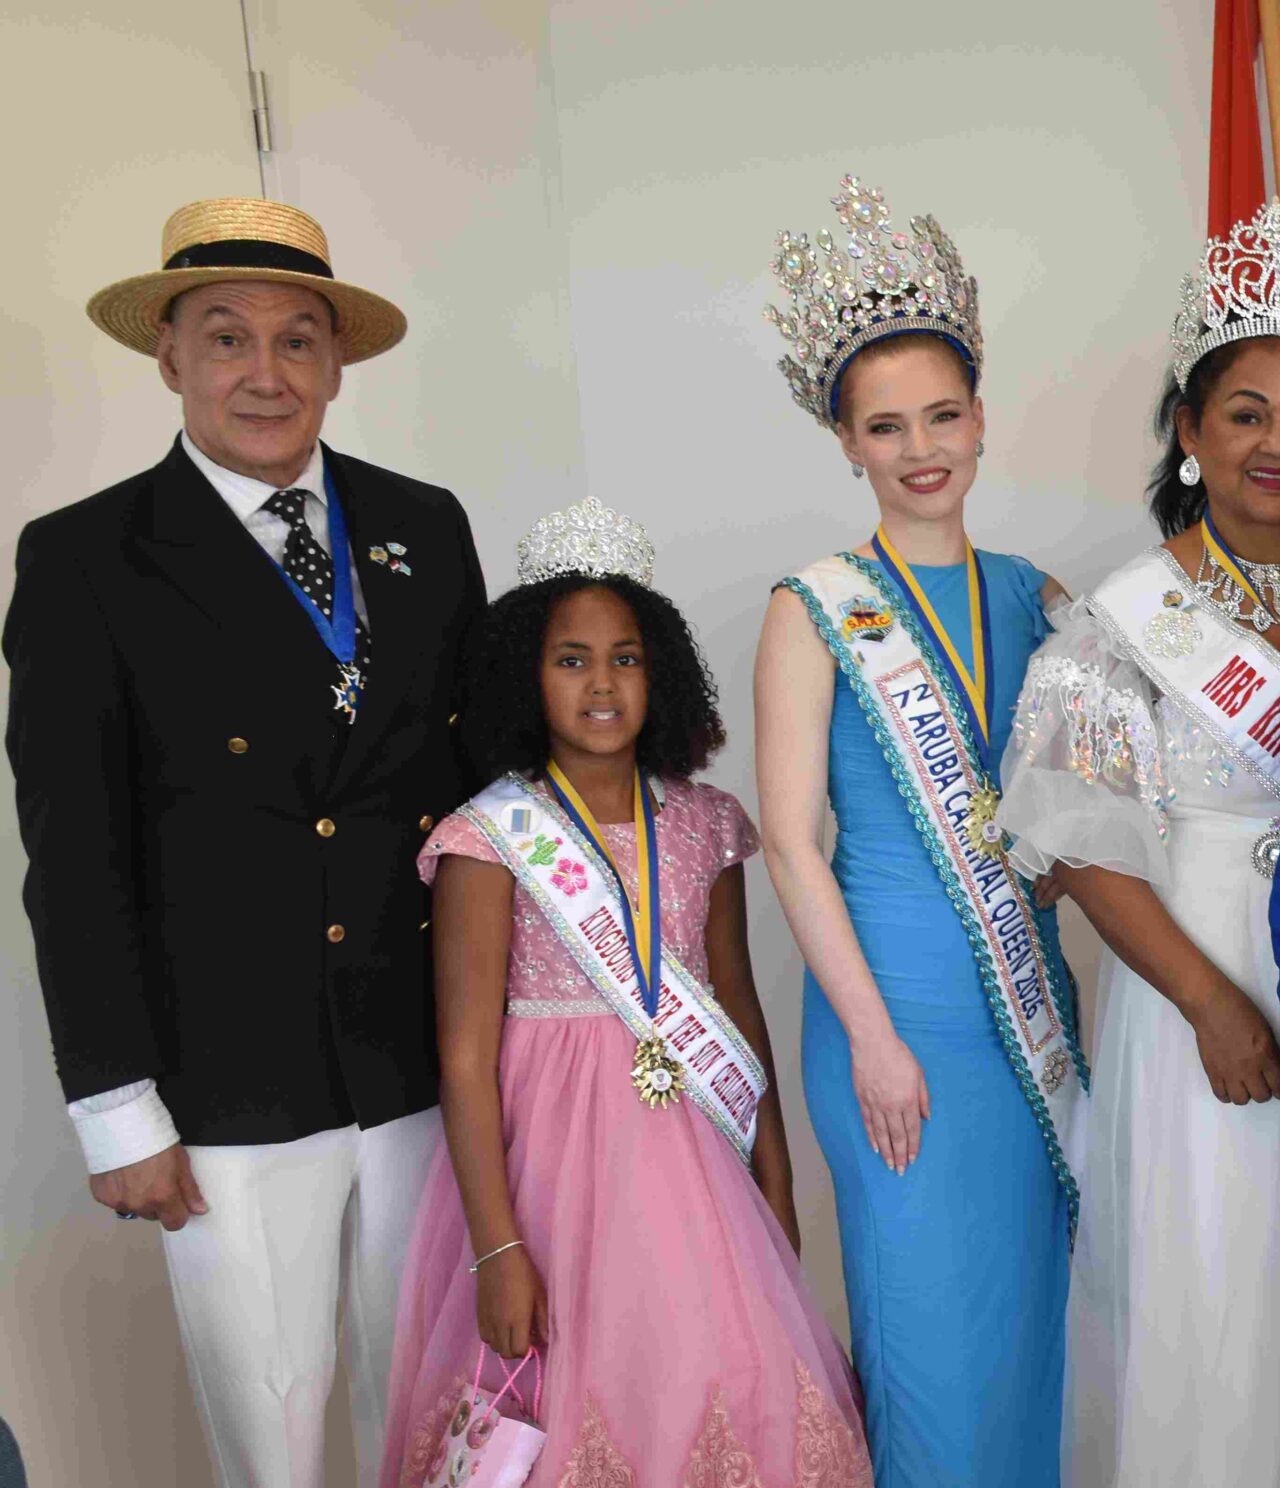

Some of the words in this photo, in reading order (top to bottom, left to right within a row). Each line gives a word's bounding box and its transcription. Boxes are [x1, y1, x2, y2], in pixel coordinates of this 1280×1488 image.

[1201, 655, 1267, 718] MRS
[908, 710, 964, 794] ARUBA
[989, 899, 1034, 976] QUEEN
[1014, 967, 1044, 1021] 2026
[578, 905, 636, 984] KINGDOMS
[666, 1014, 708, 1053] THE
[687, 1039, 727, 1076] SUN
